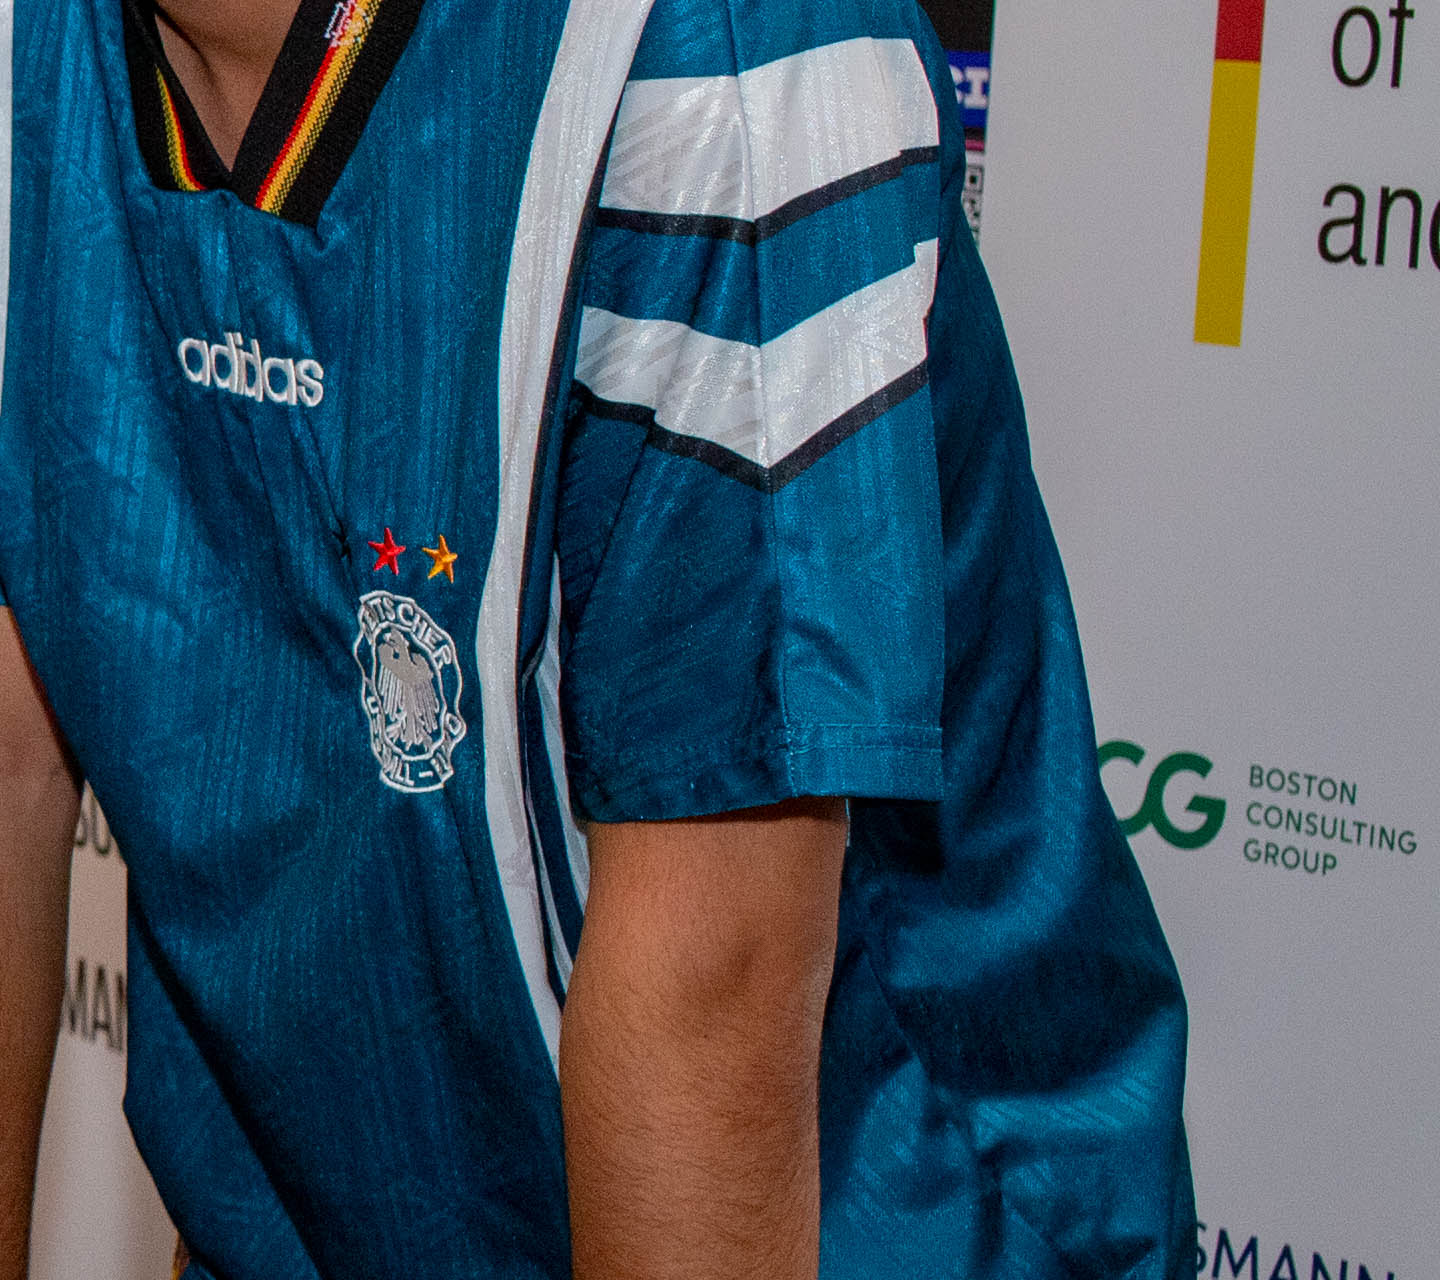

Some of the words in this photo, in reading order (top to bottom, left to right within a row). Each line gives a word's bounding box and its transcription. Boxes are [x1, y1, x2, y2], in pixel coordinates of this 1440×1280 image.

[178, 331, 325, 408] adidas
[1096, 739, 1227, 851] CG
[1248, 764, 1358, 807] BOSTON
[1245, 802, 1419, 856] CONSULTING
[1241, 838, 1339, 877] GROUP
